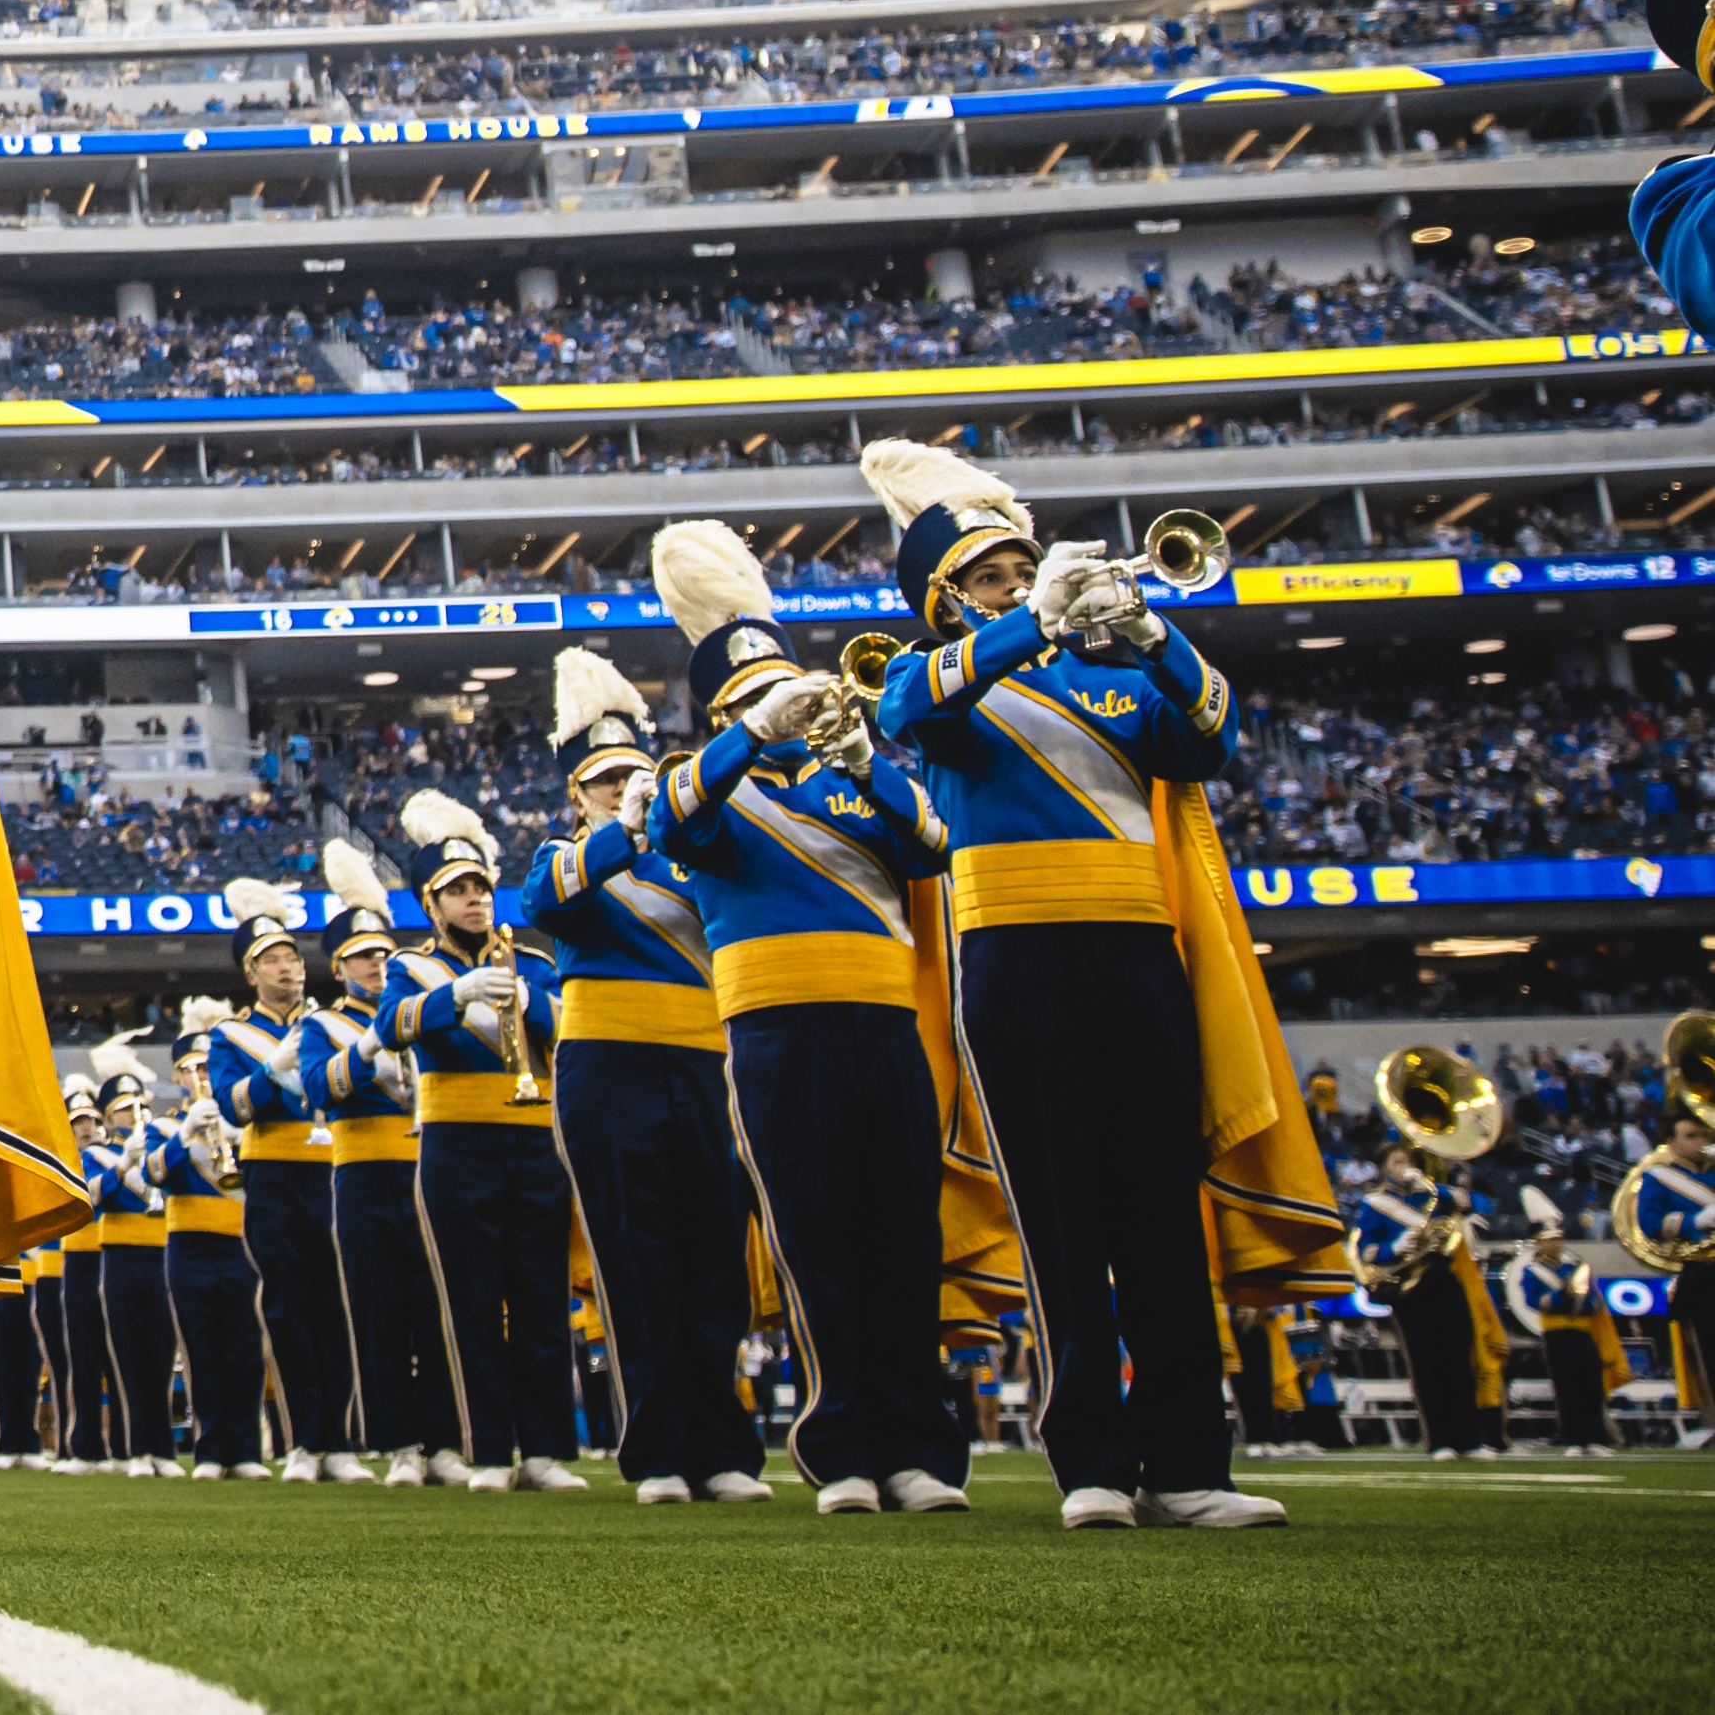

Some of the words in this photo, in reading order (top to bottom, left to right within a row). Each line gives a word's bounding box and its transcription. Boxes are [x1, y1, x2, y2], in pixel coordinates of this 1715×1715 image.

[309, 119, 428, 145] RAMS
[448, 114, 589, 140] HOUSE
[1283, 575, 1412, 595] Efficiency
[802, 594, 851, 612] Down
[260, 608, 293, 631] 16
[1247, 865, 1419, 905] USE
